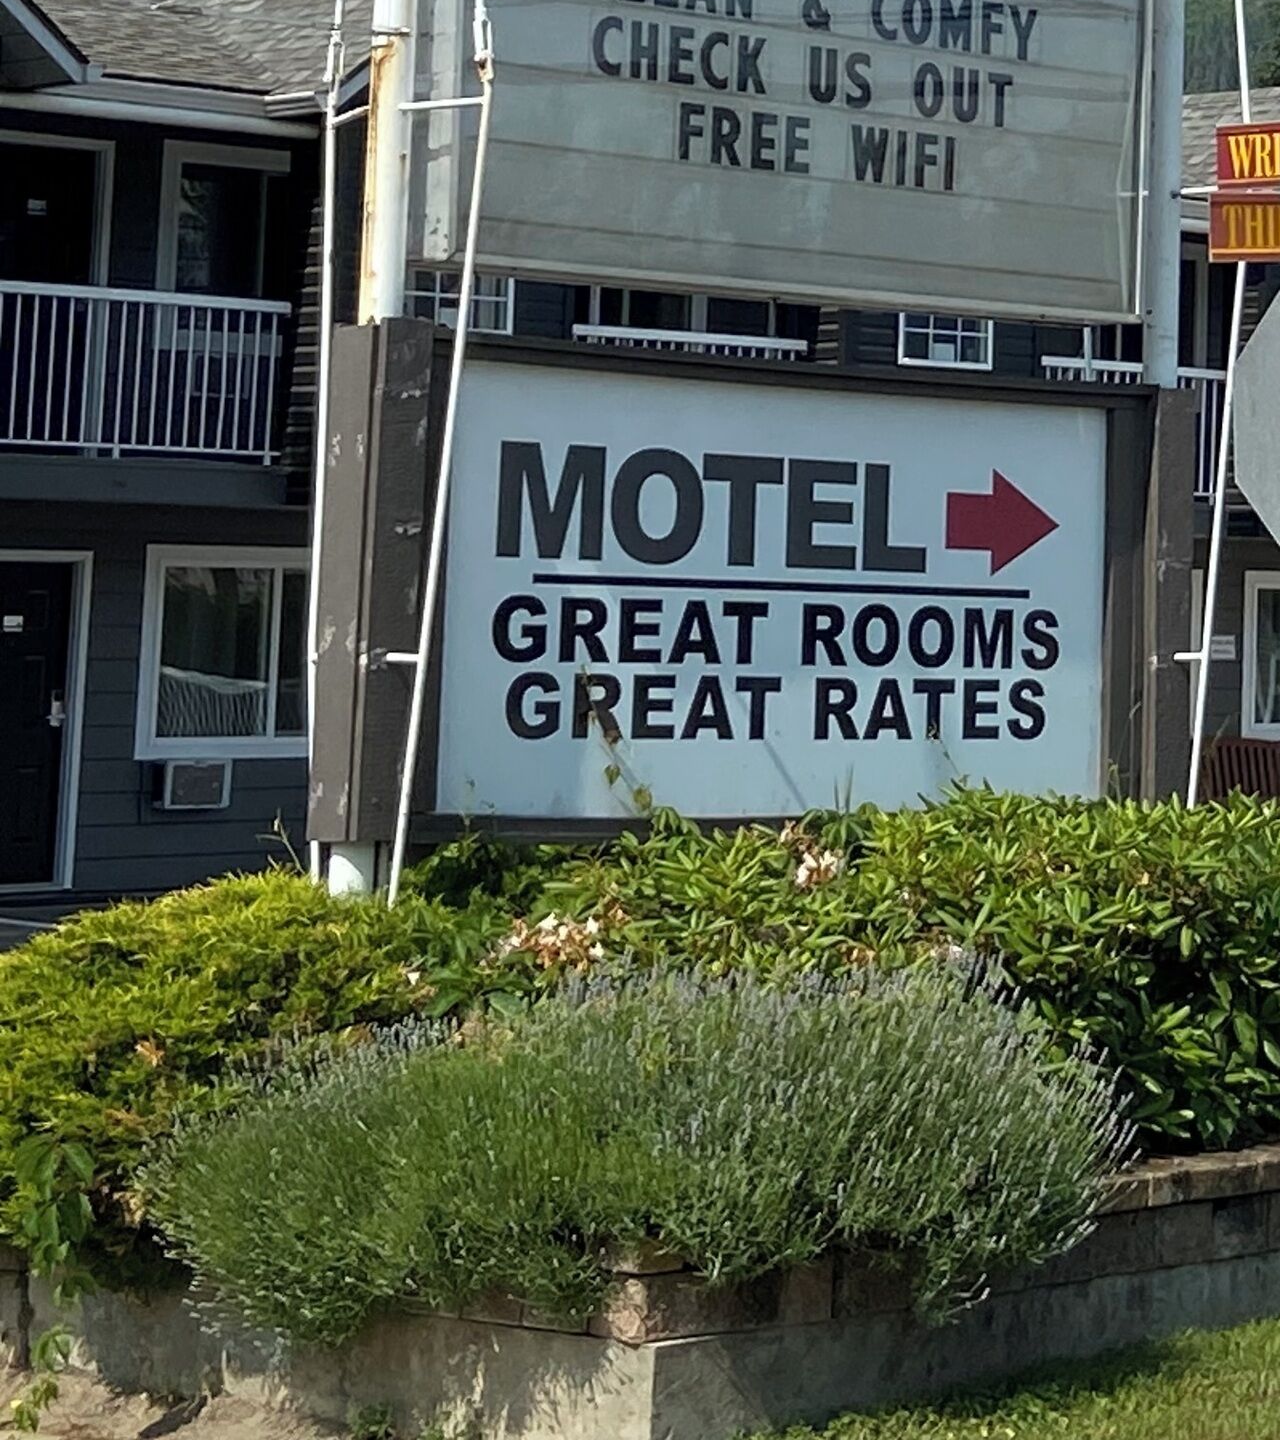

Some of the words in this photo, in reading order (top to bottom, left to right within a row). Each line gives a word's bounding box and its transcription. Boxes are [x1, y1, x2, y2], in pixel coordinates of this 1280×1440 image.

[592, 15, 766, 95] CHECK
[808, 46, 872, 109] US
[914, 63, 1014, 128] OUT
[679, 101, 811, 174] FREE
[851, 124, 957, 191] WIFI
[495, 440, 927, 574] MOTEL
[492, 594, 769, 665] GREAT
[800, 602, 1060, 670] ROOMS
[505, 672, 782, 740] GREAT
[813, 677, 1046, 740] RATES
